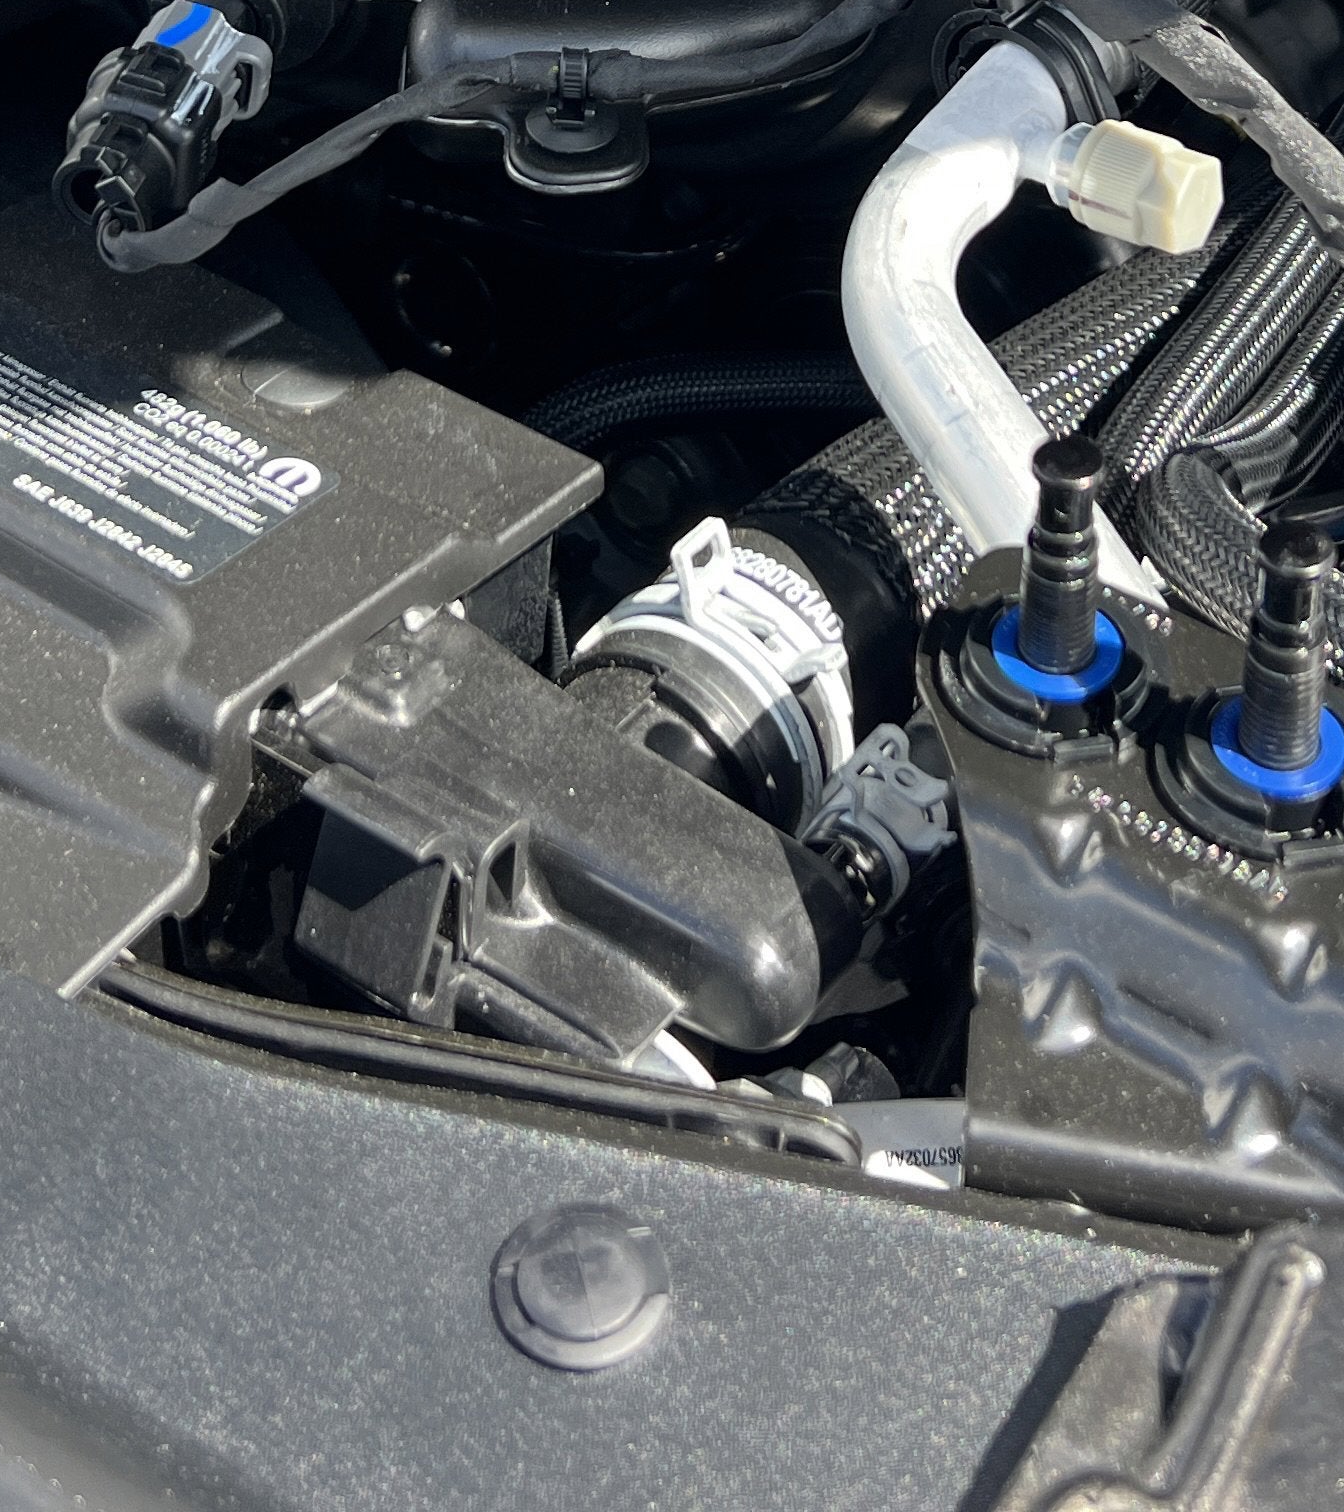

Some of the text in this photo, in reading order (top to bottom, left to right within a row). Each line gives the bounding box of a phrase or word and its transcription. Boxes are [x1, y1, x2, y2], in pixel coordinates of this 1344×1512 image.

[133, 402, 173, 427] CO2
[141, 388, 187, 419] 482g
[12, 473, 55, 501] SAE
